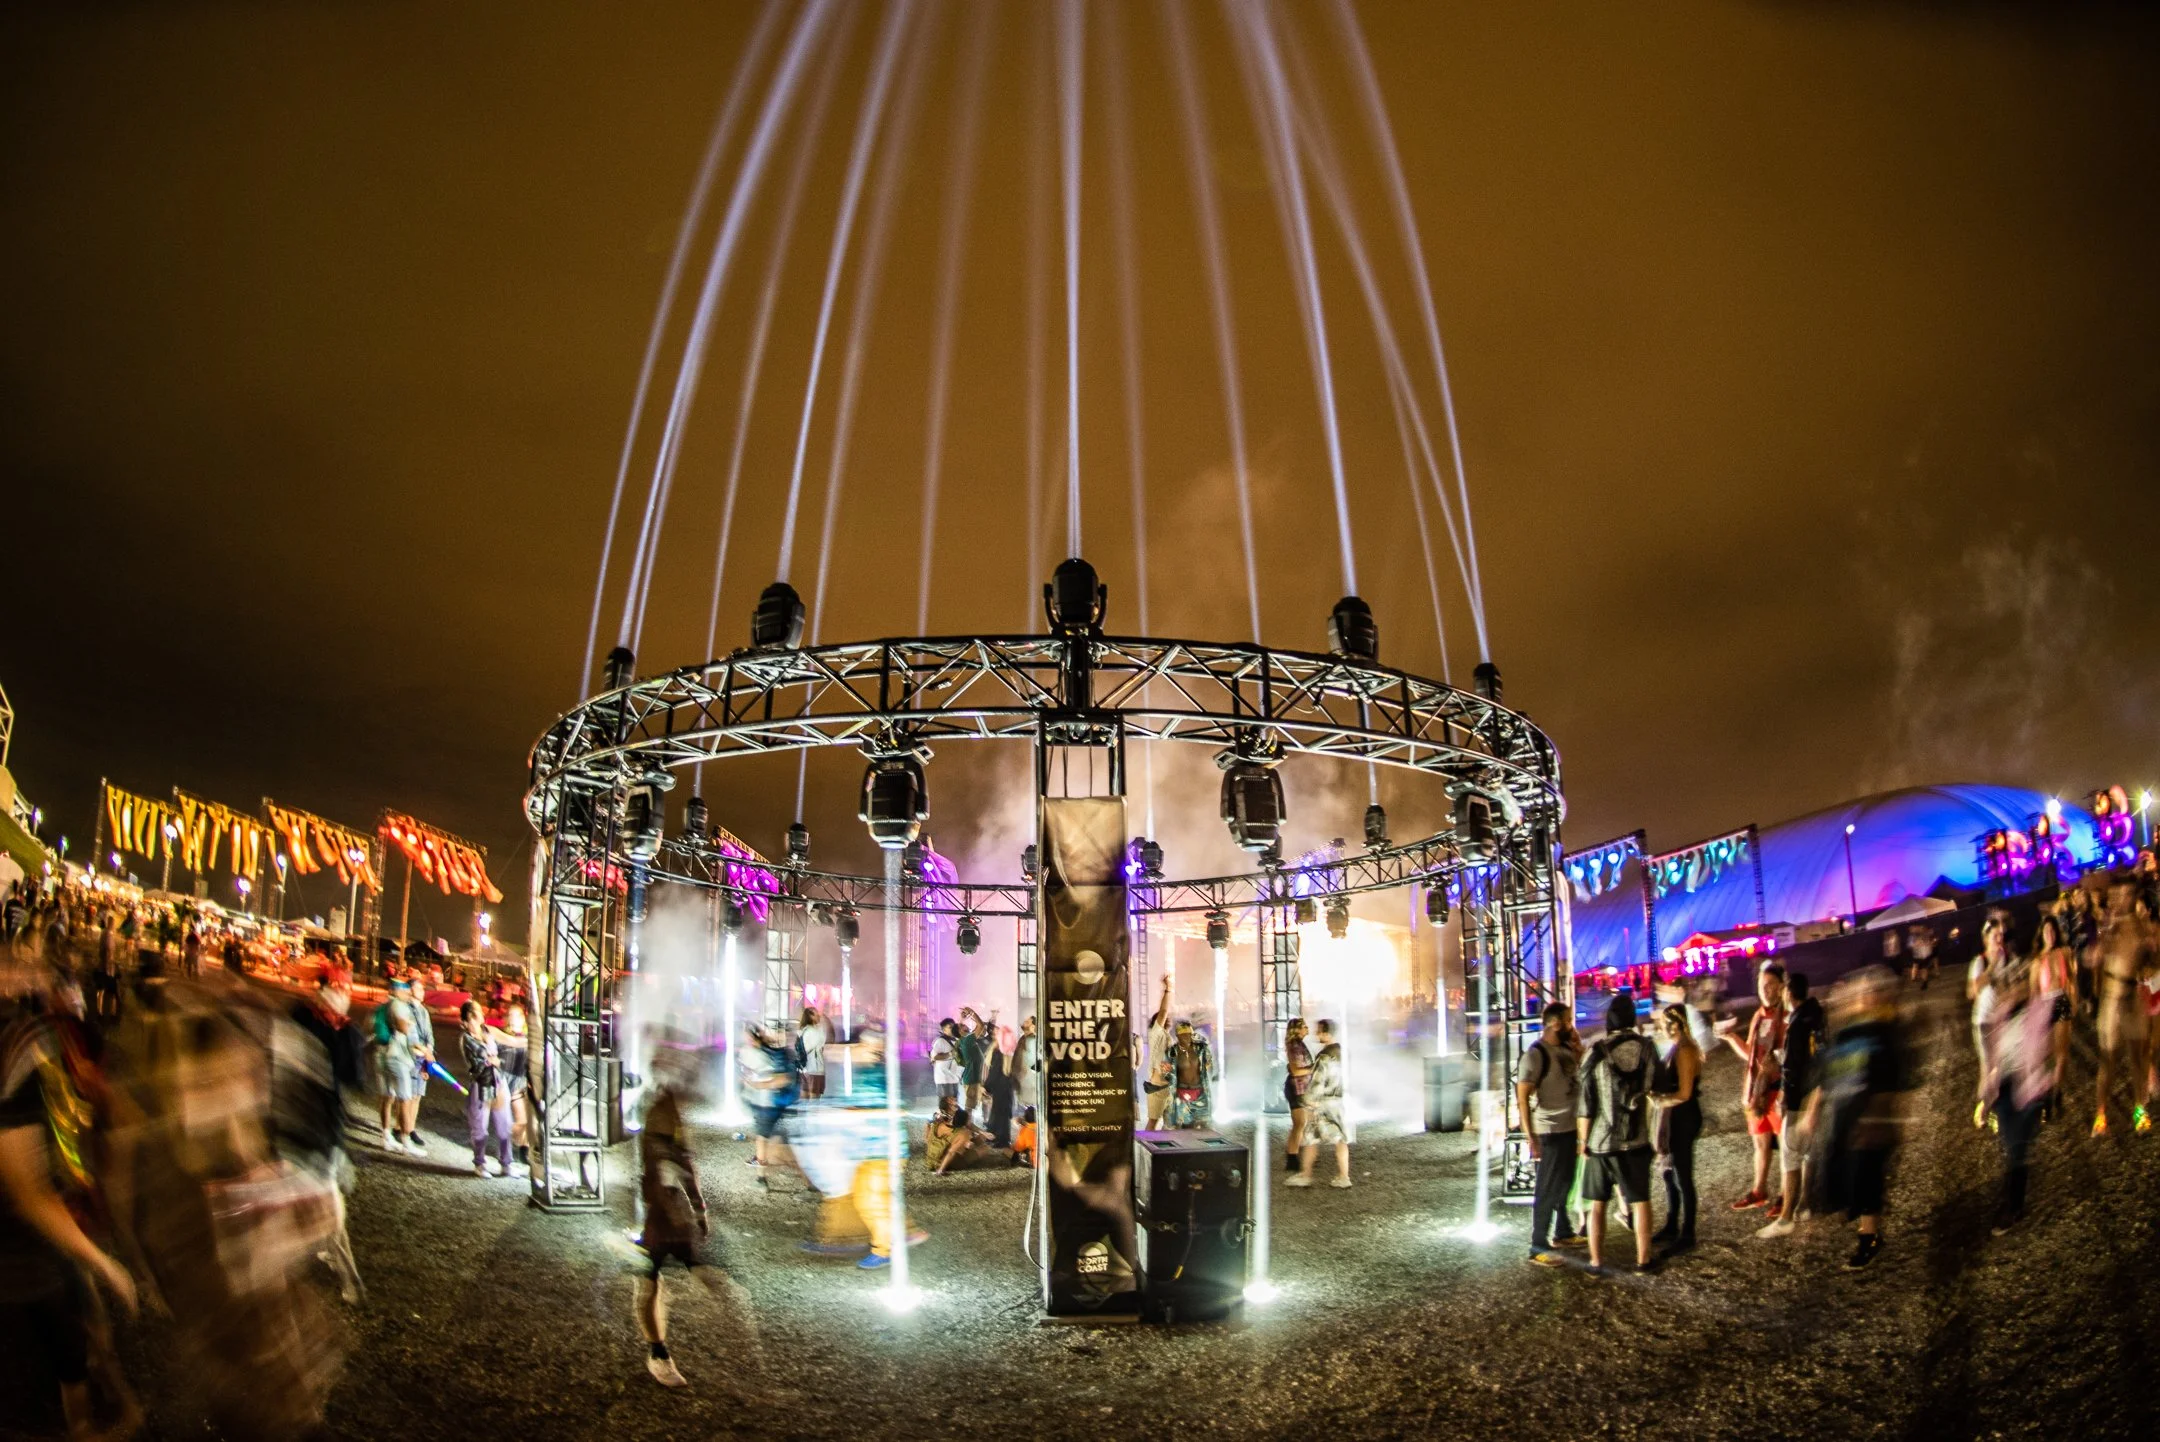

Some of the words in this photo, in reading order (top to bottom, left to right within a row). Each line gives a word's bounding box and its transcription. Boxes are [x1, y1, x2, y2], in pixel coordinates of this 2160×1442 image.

[1050, 999, 1126, 1019] ENTER
[1049, 1020, 1096, 1039] THE
[1050, 1041, 1112, 1061] VOID
[1077, 1256, 1108, 1265] NORTH
[1077, 1263, 1108, 1273] COAST
